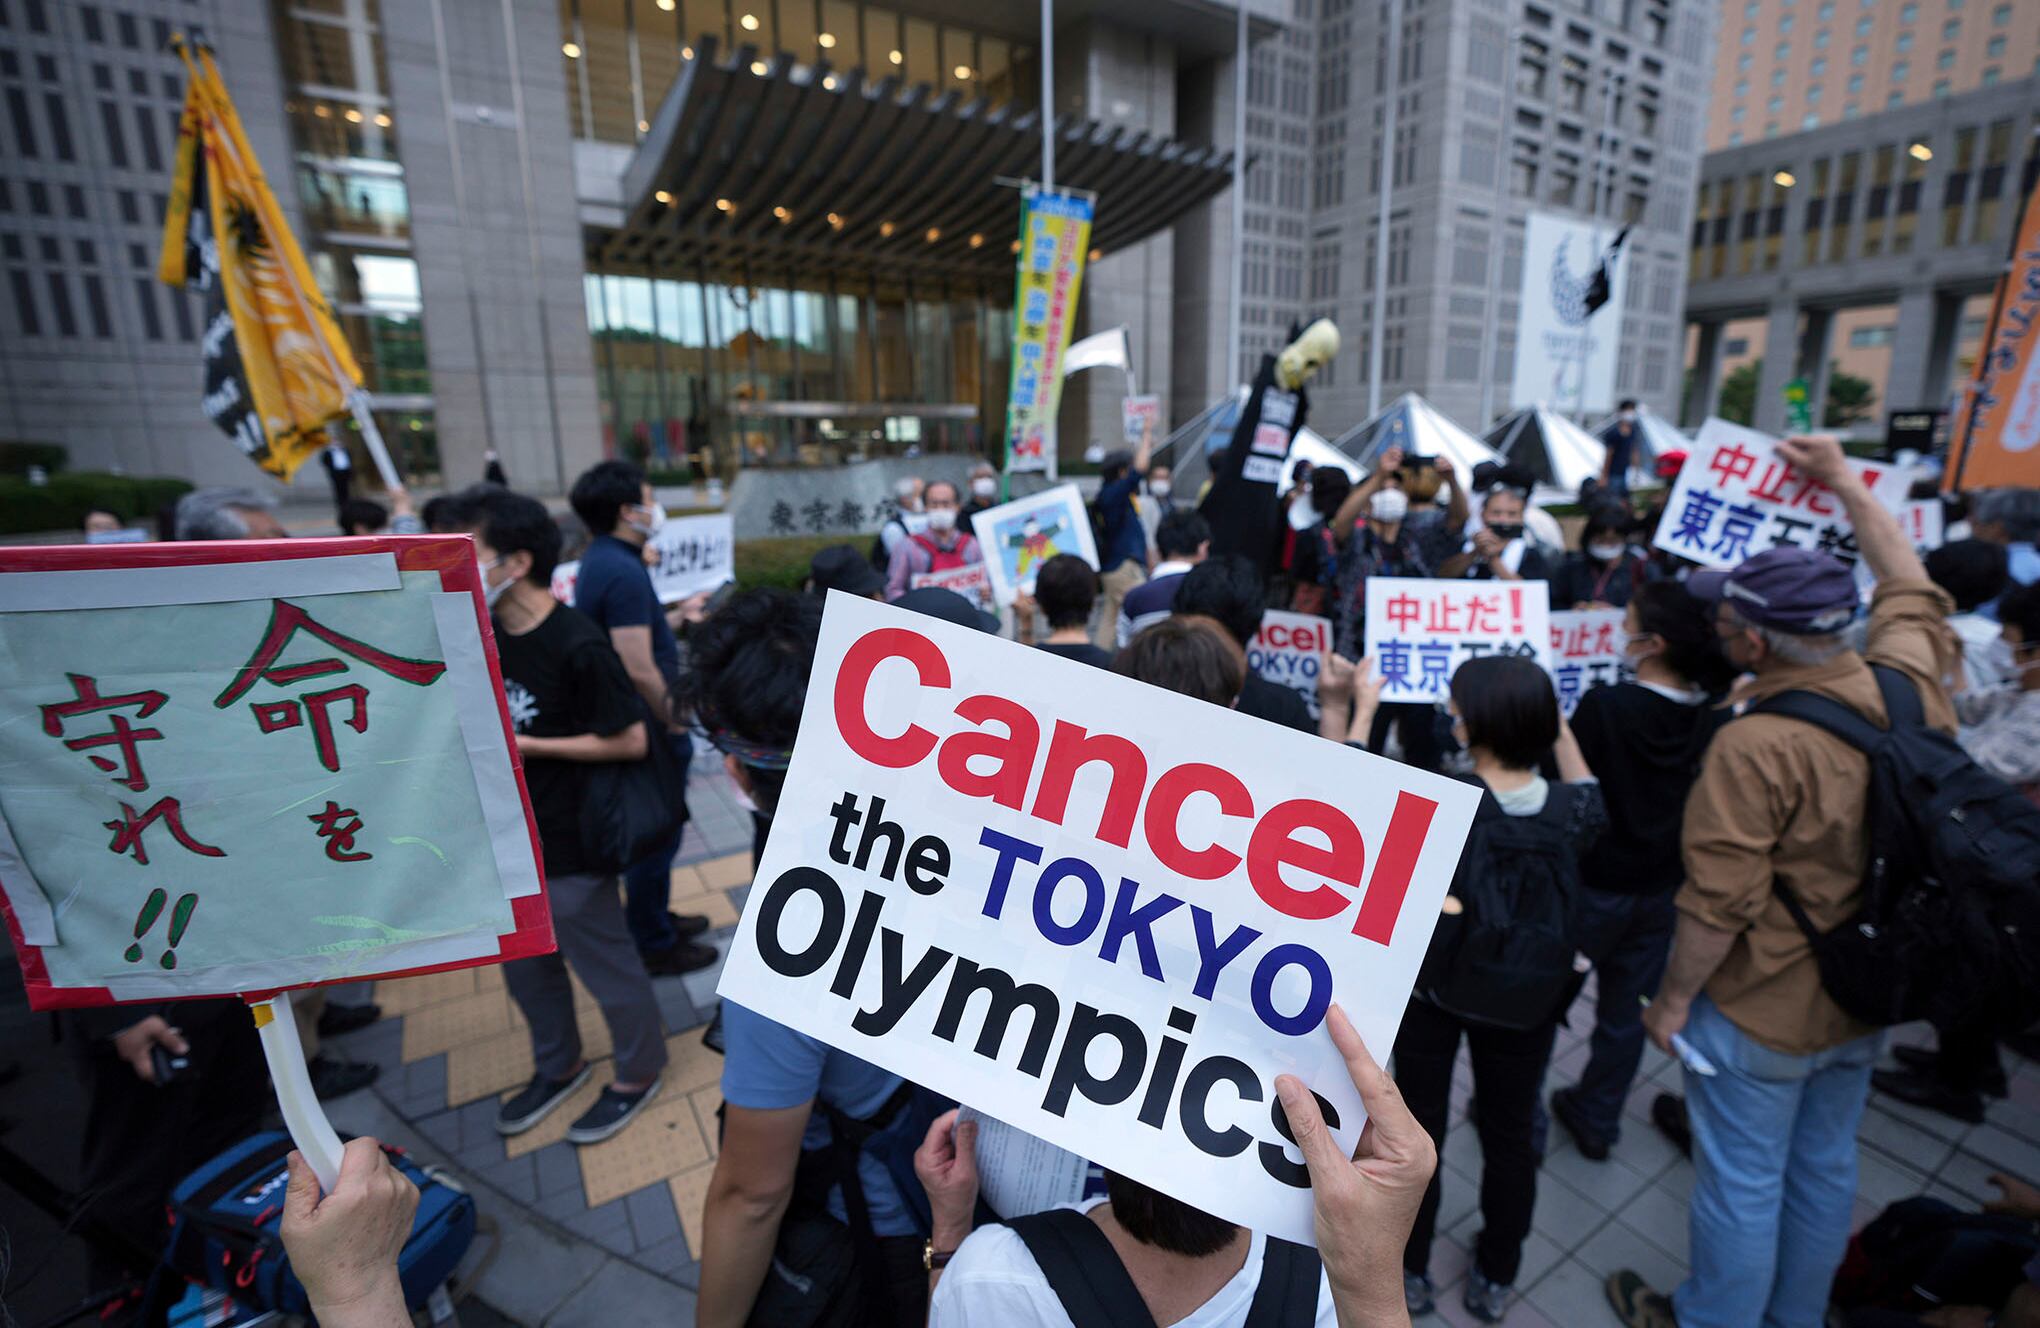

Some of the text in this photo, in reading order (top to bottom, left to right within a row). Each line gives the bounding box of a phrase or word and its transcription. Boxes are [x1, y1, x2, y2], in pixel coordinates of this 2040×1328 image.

[214, 598, 446, 862] 命を
[1386, 588, 1524, 636] 中止だ！
[829, 792, 1333, 1036] the TOKYO
[834, 628, 1438, 945] Cancel
[756, 867, 1340, 1188] Olympics
